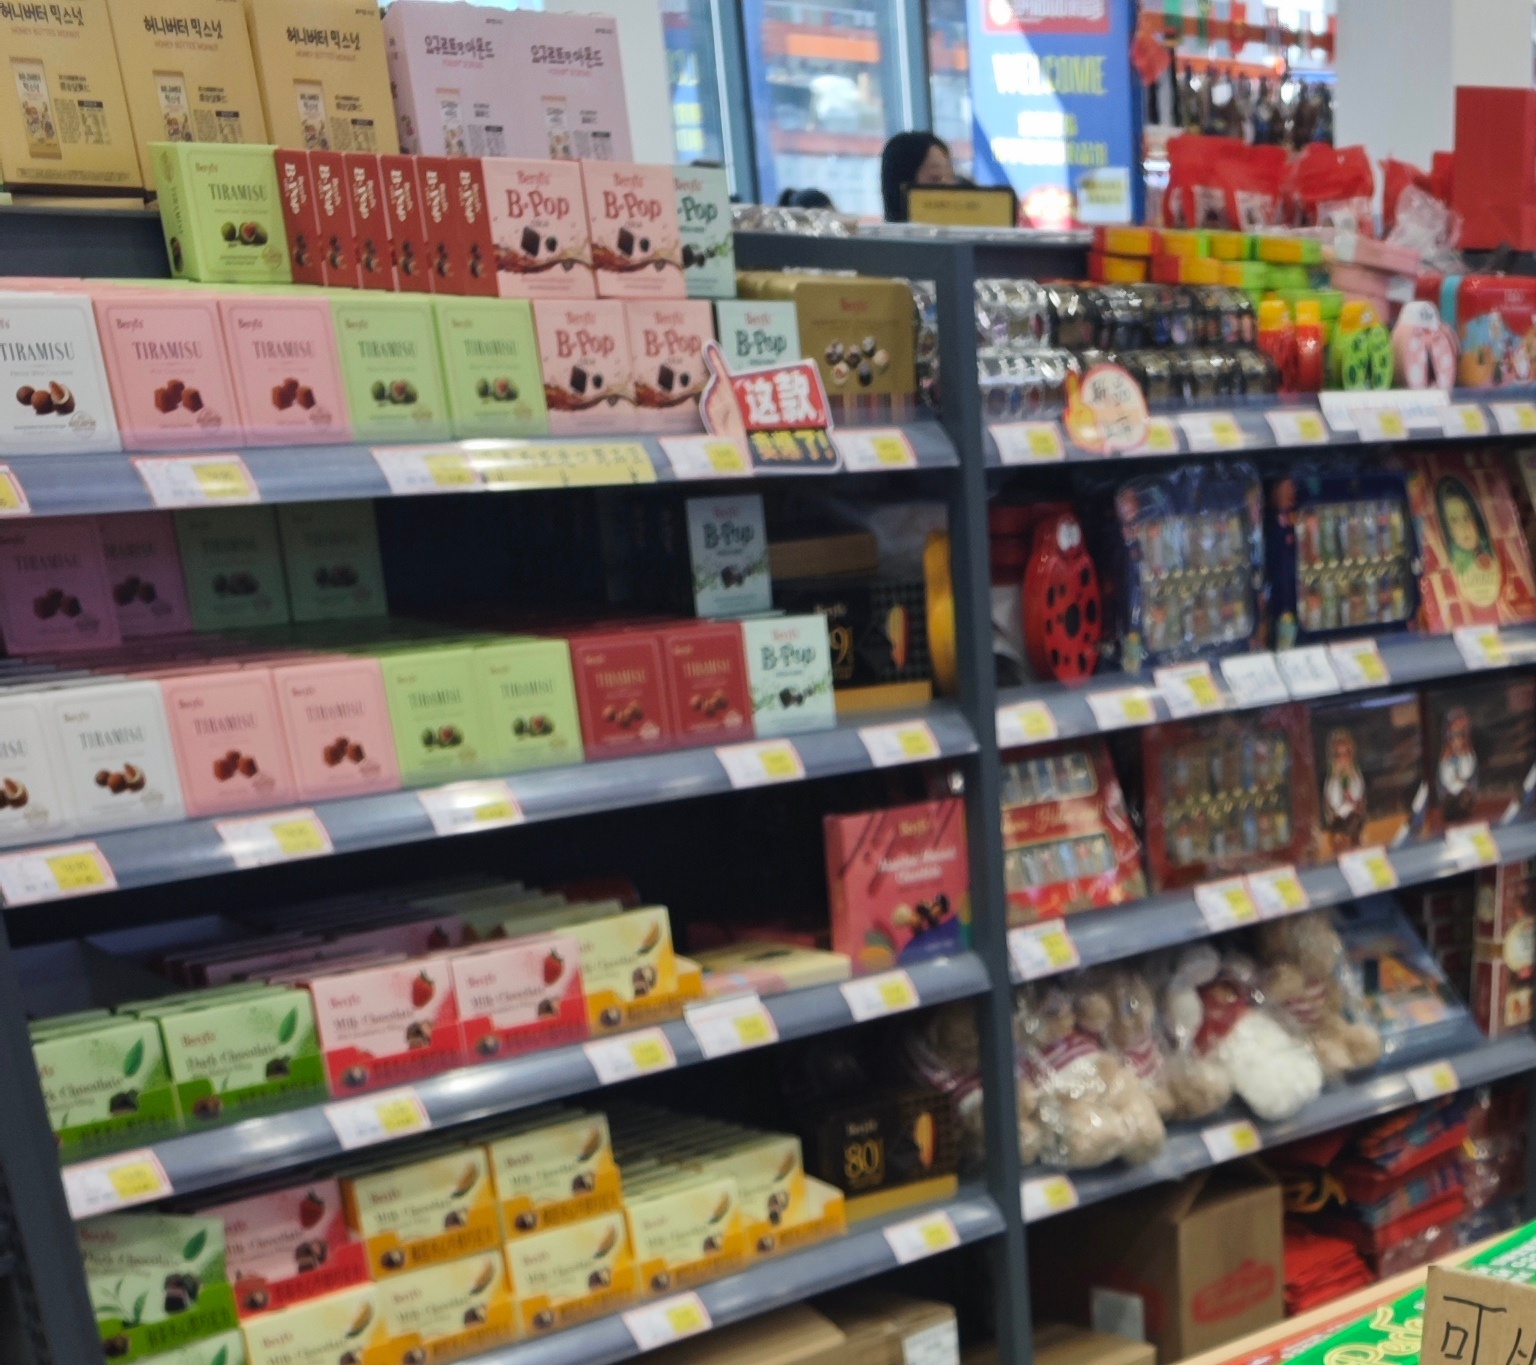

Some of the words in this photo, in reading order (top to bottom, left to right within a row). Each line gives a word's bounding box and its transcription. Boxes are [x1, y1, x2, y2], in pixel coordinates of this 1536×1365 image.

[208, 183, 268, 201] TIRAMISU
[1, 342, 75, 361] TIRAMISU
[132, 341, 203, 361] TIRAMISU
[252, 341, 315, 359] TIRAMISU
